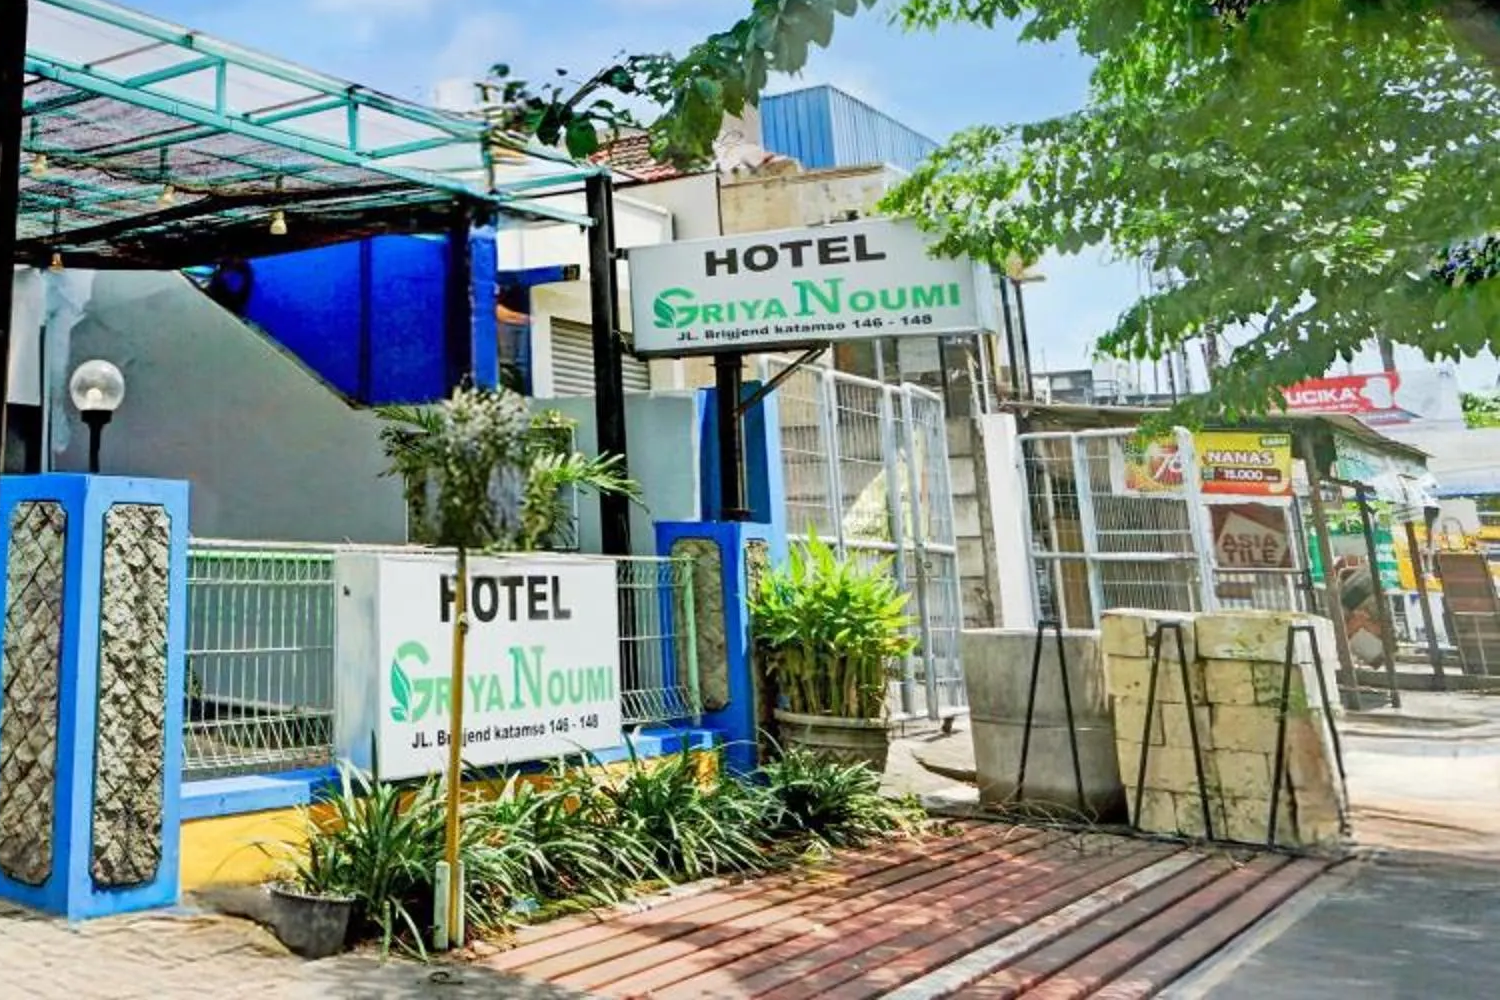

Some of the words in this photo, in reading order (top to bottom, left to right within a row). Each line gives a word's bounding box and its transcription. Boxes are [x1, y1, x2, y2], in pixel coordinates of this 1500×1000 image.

[705, 234, 887, 277] HOTEL
[653, 287, 788, 329] GRIYA
[791, 277, 961, 318] NOUMI
[677, 332, 699, 342] JL.
[704, 325, 770, 341] Brigjend
[774, 320, 846, 334] katamso
[852, 317, 883, 329] 146
[900, 314, 933, 325] 148
[1276, 386, 1357, 406] UCIKA
[1207, 450, 1274, 466] NANAS
[1222, 533, 1280, 549] ASIA
[1223, 548, 1279, 565] TILE
[439, 574, 571, 623] HOTEL
[389, 640, 506, 725] GRYA
[508, 645, 614, 710] NOUMI
[411, 732, 433, 749] JL.
[437, 727, 491, 747] Brjend
[494, 723, 546, 741] katamso
